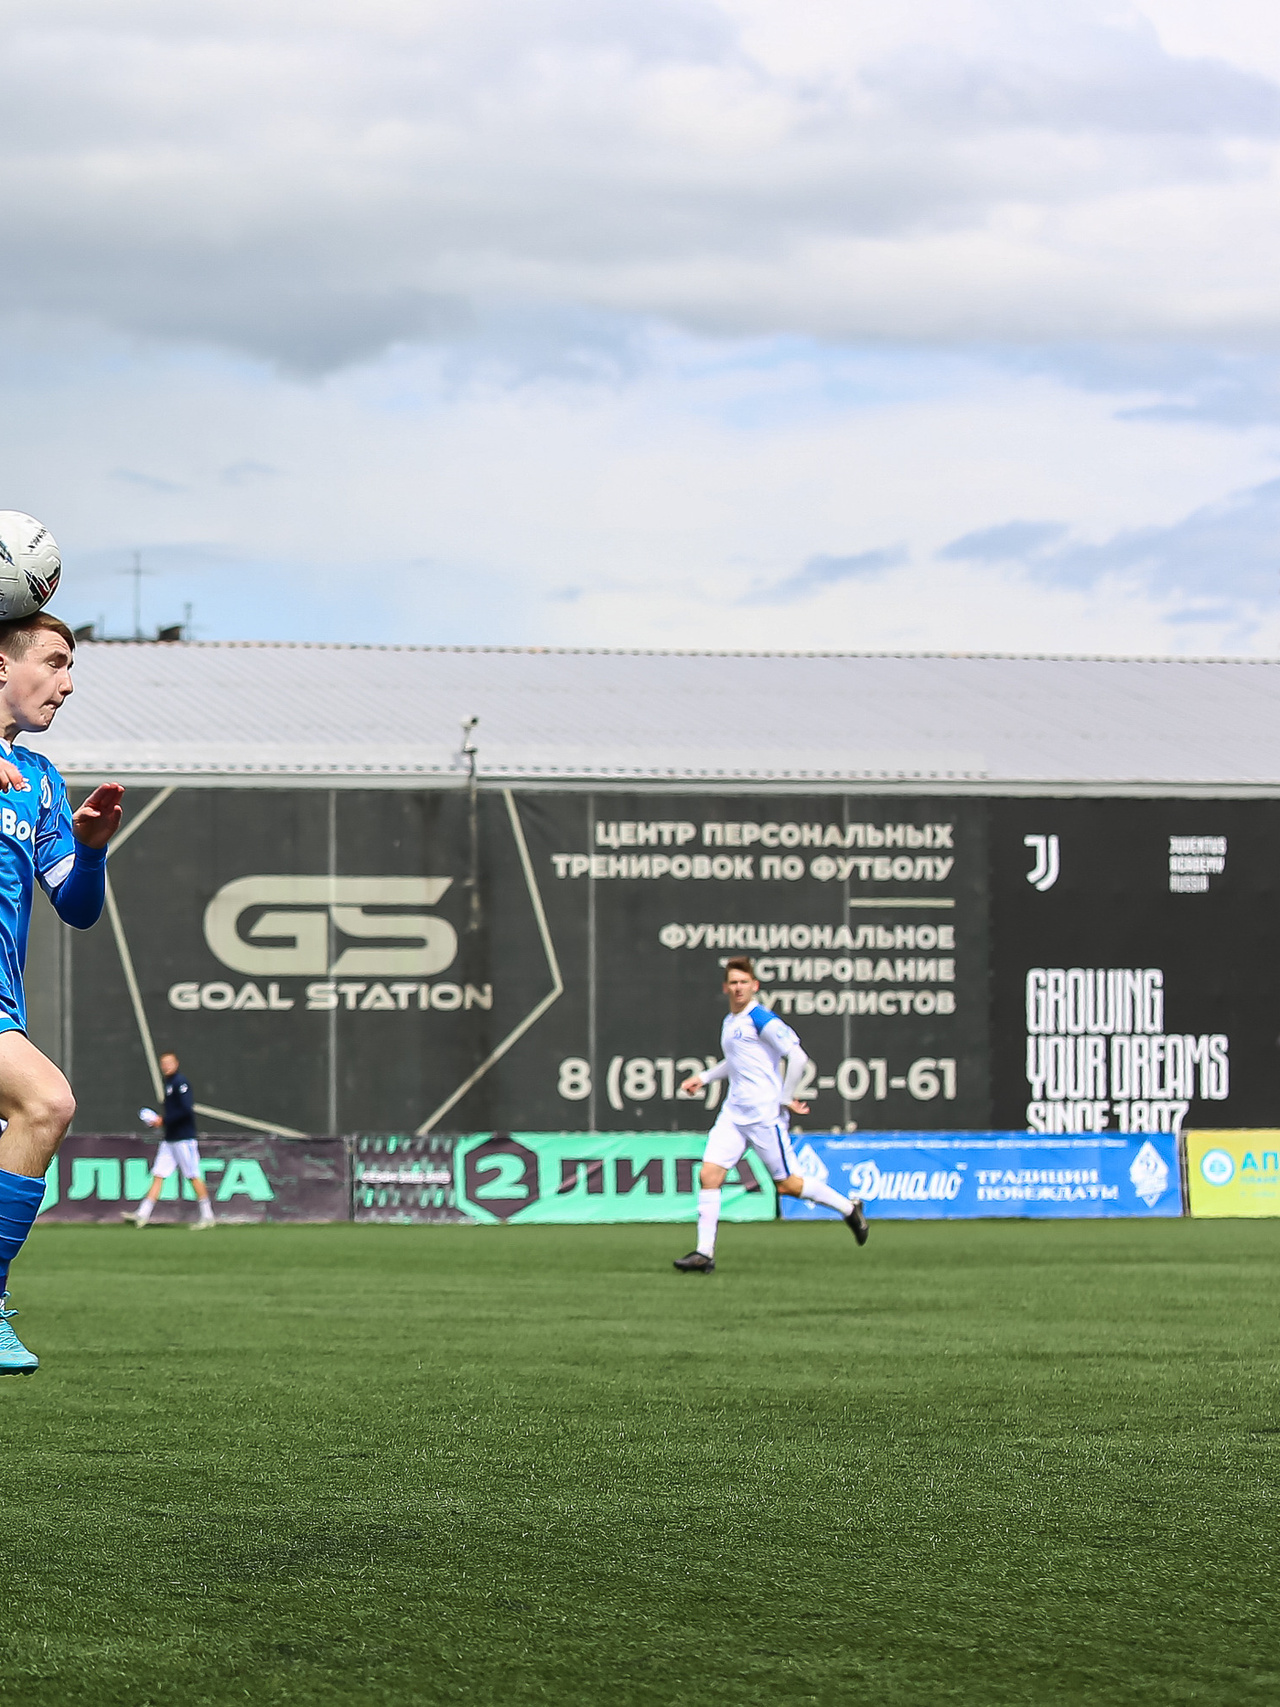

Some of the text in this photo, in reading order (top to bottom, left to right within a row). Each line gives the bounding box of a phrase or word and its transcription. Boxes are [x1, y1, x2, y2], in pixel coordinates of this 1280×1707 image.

[595, 822, 954, 849] ЦЕНТР ПЕРСОНАЛЬНЫХ
[552, 854, 954, 881] ТРЕНИРОВОК ПО ФУТБОЛУ
[203, 874, 458, 977] GS
[659, 923, 955, 951] ФУНКЦИОНАЛЬНОЕ
[718, 957, 956, 983] СТИРОВАНИЕ
[168, 983, 494, 1011] GOAL STATION
[753, 989, 956, 1016] УТБОЛИСТОВ
[1026, 967, 1164, 1035] GROWING
[557, 1057, 593, 1101] 8
[1026, 1034, 1229, 1100] YOUR DREAMS
[476, 1153, 530, 1199] 2
[974, 1168, 1099, 1185] ТРАДИЦИИ
